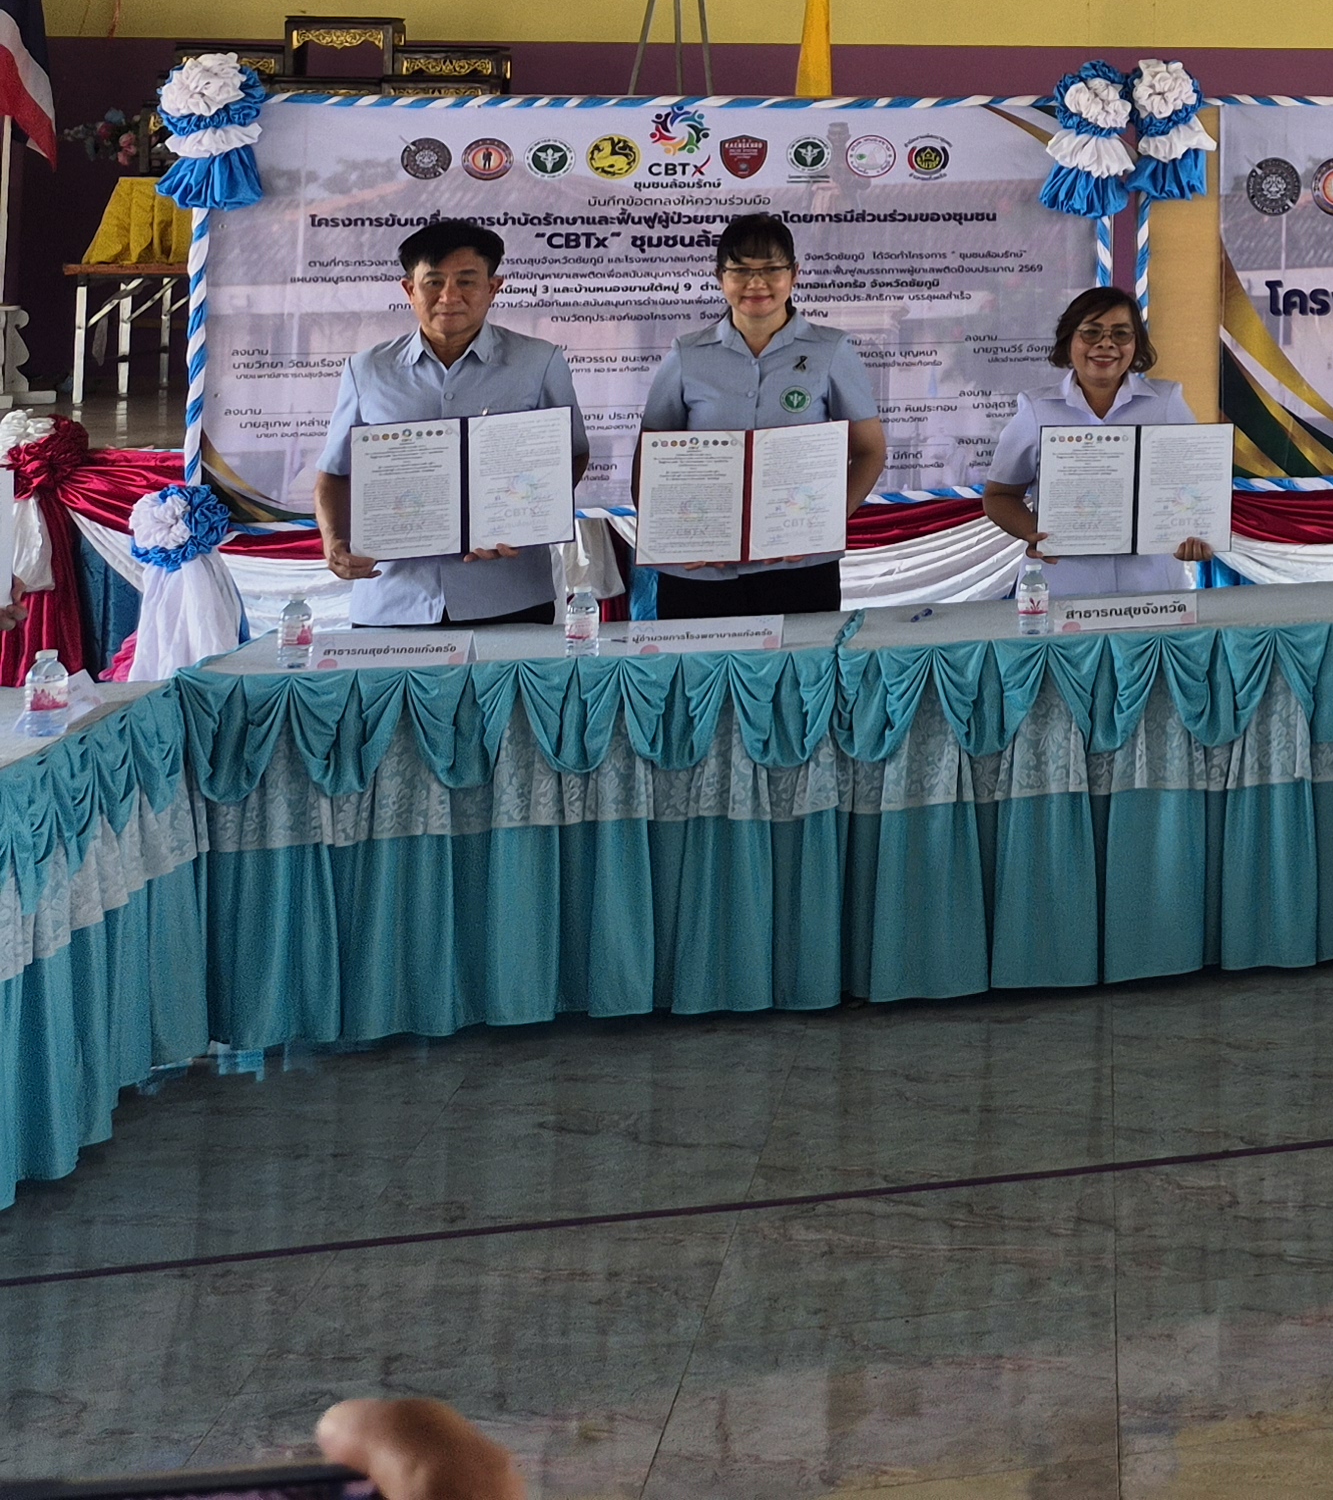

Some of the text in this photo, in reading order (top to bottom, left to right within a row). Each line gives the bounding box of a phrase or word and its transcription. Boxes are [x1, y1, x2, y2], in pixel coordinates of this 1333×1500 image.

[633, 177, 723, 192] ชุมชนล้อมรักษ์
[588, 193, 772, 208] บันทึกข้อตกลงให้ความร่วมมือ
[803, 250, 866, 262] จังหวัดชัยภูมิ
[1017, 263, 1043, 273] 2569
[541, 285, 550, 294] 3
[684, 283, 692, 292] 9
[870, 278, 940, 290] จังหวัดชัยภูมิ
[964, 333, 998, 343] ลงนาม
[231, 347, 269, 357] ลงนาม
[232, 358, 284, 370] นายวิทยา
[958, 389, 992, 398] ลงนาม
[223, 407, 262, 417] ลงนาม
[957, 437, 991, 446] ลงนาม
[1065, 600, 1187, 620] สาธารณสุขจังหวัด
[322, 643, 458, 657] สาธารณสุขอำเภอแก้งคร้อ
